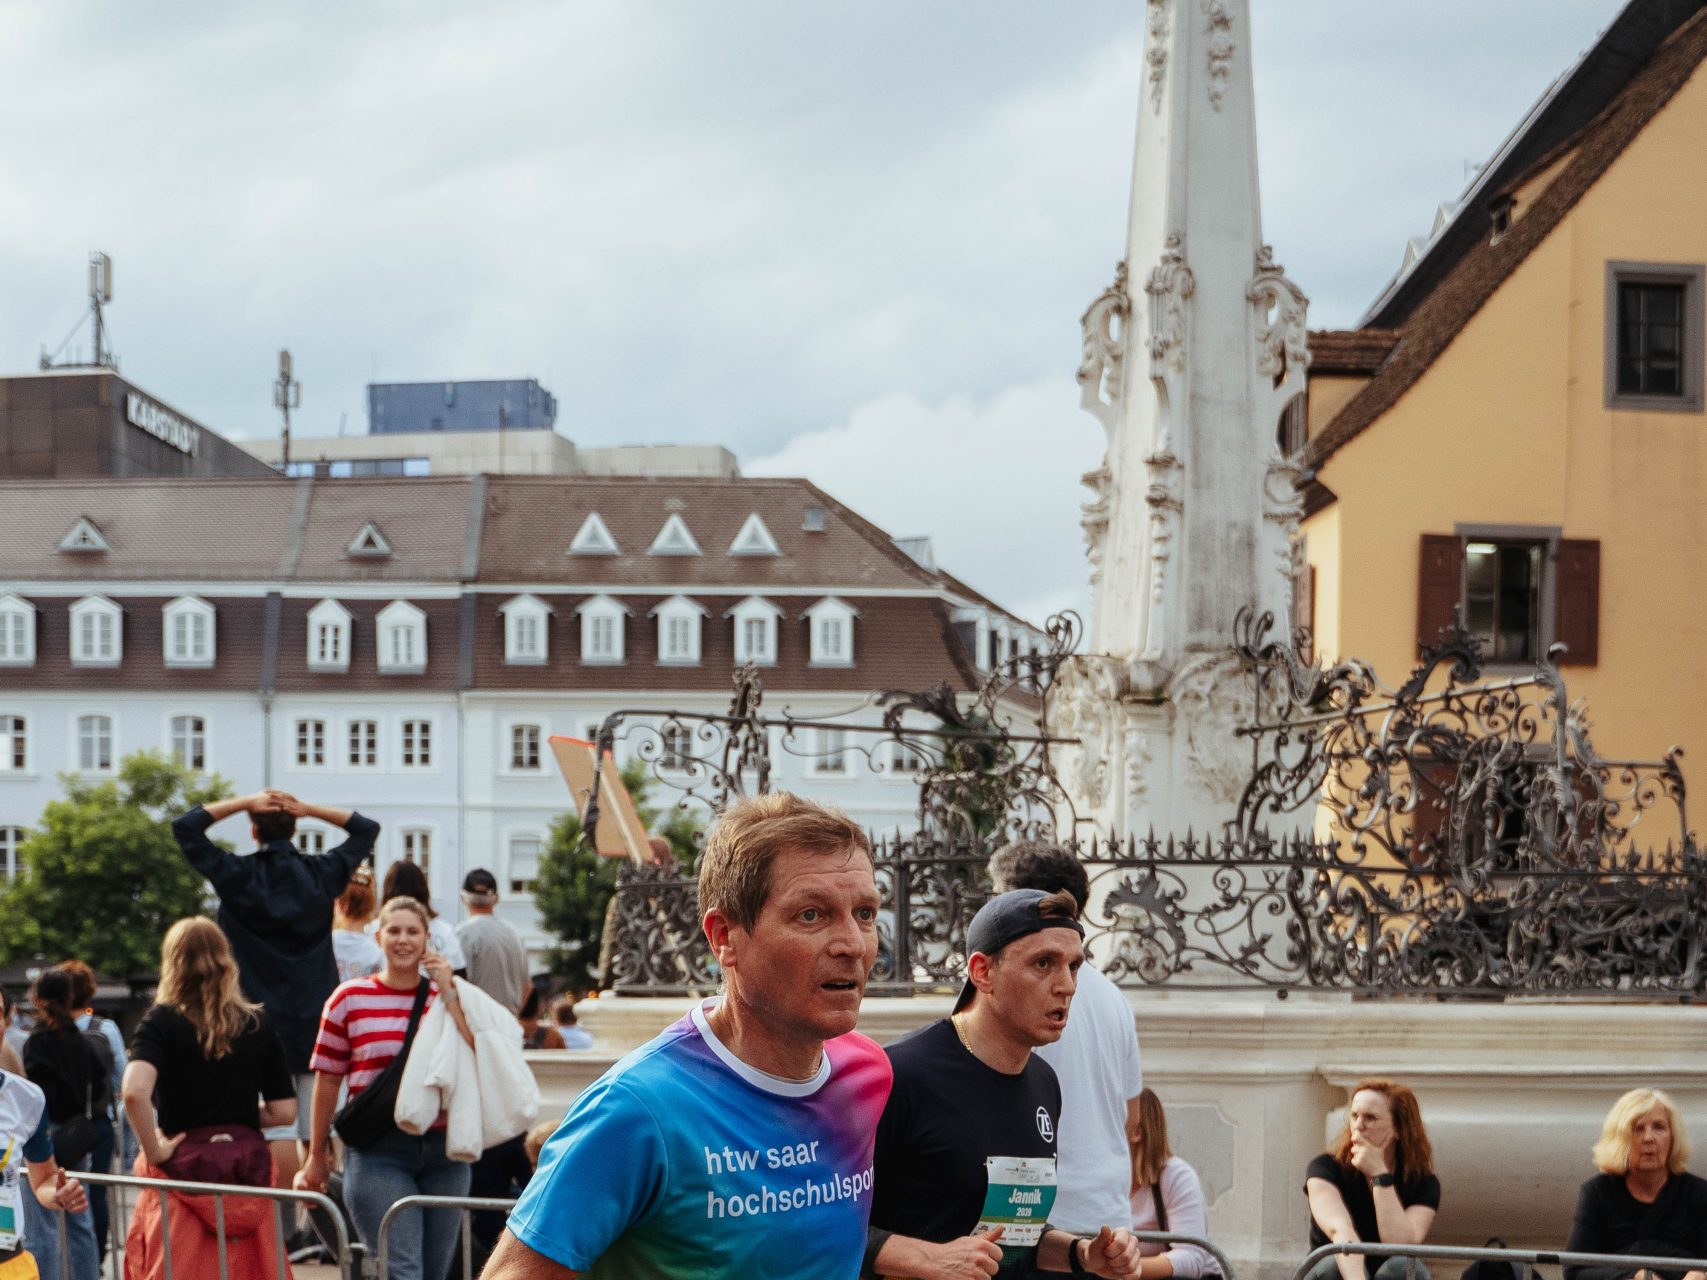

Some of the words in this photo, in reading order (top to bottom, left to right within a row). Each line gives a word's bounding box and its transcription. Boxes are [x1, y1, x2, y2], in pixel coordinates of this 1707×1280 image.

[704, 1146, 760, 1175] htw
[767, 1140, 819, 1170] saar
[707, 1160, 874, 1219] hochschulspor
[1008, 1187, 1042, 1205] Jannik
